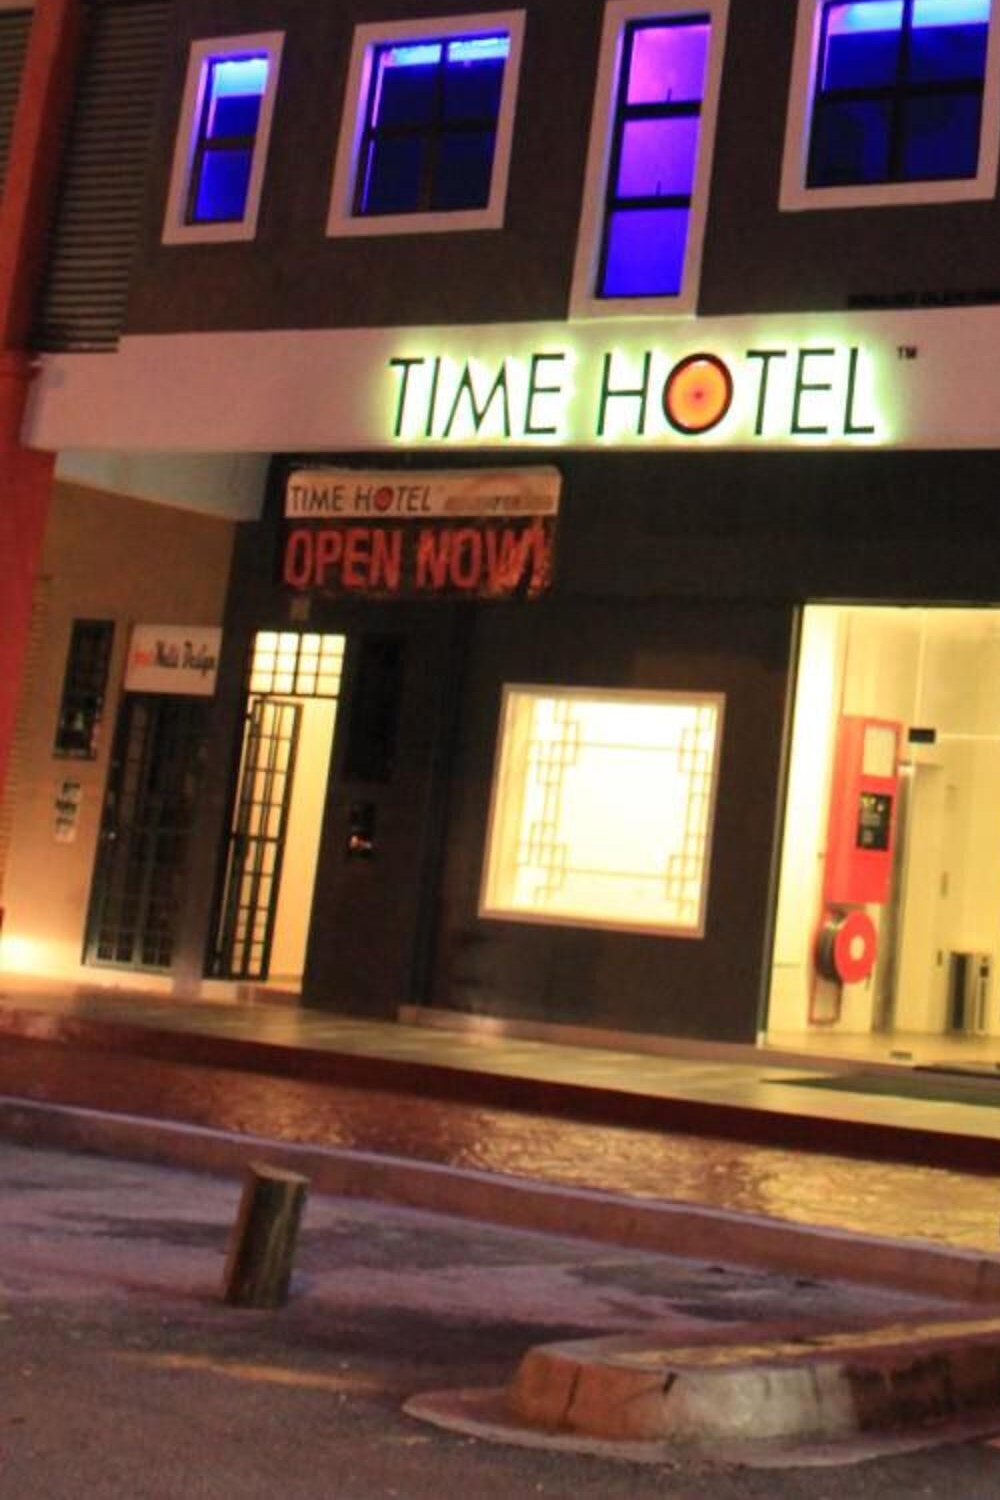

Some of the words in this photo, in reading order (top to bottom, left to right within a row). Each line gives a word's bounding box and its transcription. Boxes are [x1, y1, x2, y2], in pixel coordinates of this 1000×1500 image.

[389, 353, 565, 439] TIME
[596, 347, 876, 438] HOTEL
[290, 485, 345, 512] TIME
[353, 484, 432, 514] HOTEL
[285, 529, 401, 588] OPEN
